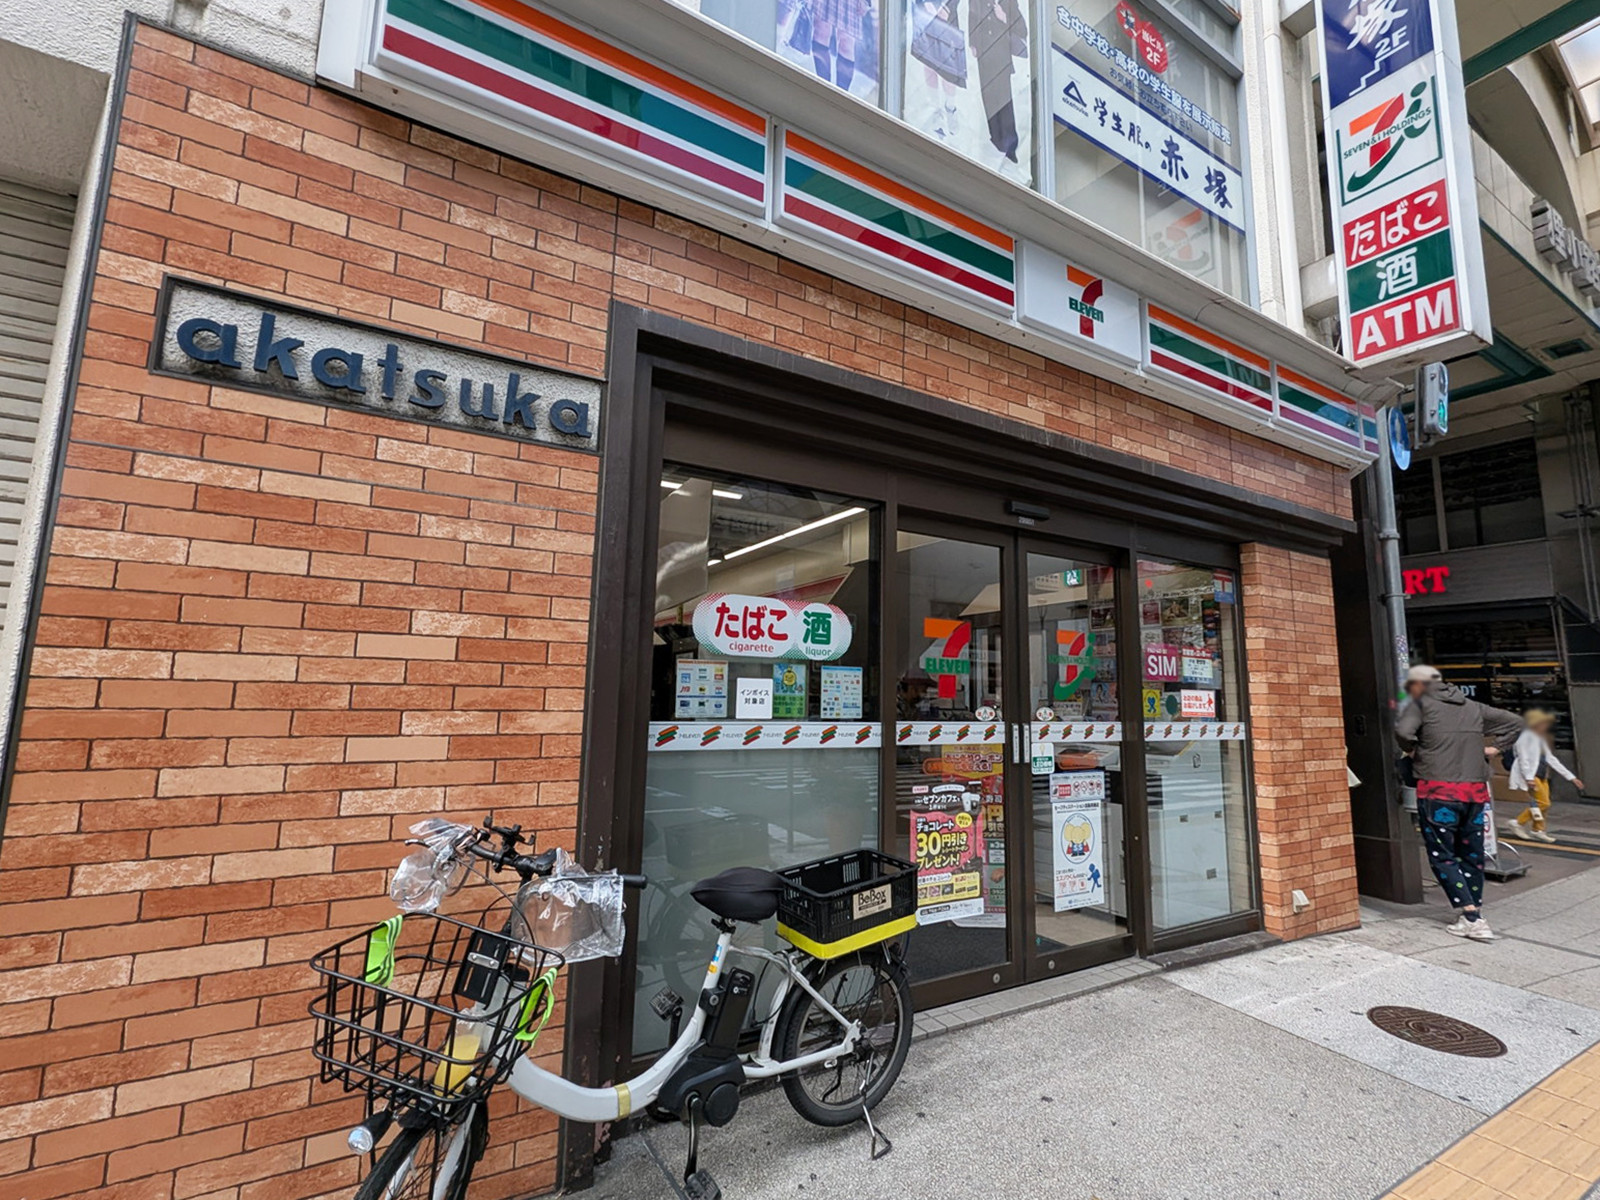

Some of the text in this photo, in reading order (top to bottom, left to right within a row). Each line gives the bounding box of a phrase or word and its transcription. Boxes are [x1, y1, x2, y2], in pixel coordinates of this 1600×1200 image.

[1146, 46, 1161, 65] 2F
[1375, 25, 1407, 59] 2F
[1382, 107, 1432, 138] HOLDINGS
[1350, 190, 1442, 262] たばこ
[1375, 246, 1418, 300] 酒
[1356, 287, 1454, 355] ATM
[176, 311, 592, 438] akatsuka
[1402, 565, 1449, 595] RT
[714, 602, 832, 645] たばこ 酒
[729, 641, 832, 657] cigarette liquor
[1147, 654, 1177, 676] SIM
[740, 689, 770, 697] インボイス
[916, 820, 955, 833] チョコレート
[916, 853, 960, 871] プレゼント!
[858, 889, 886, 906] BeBox
